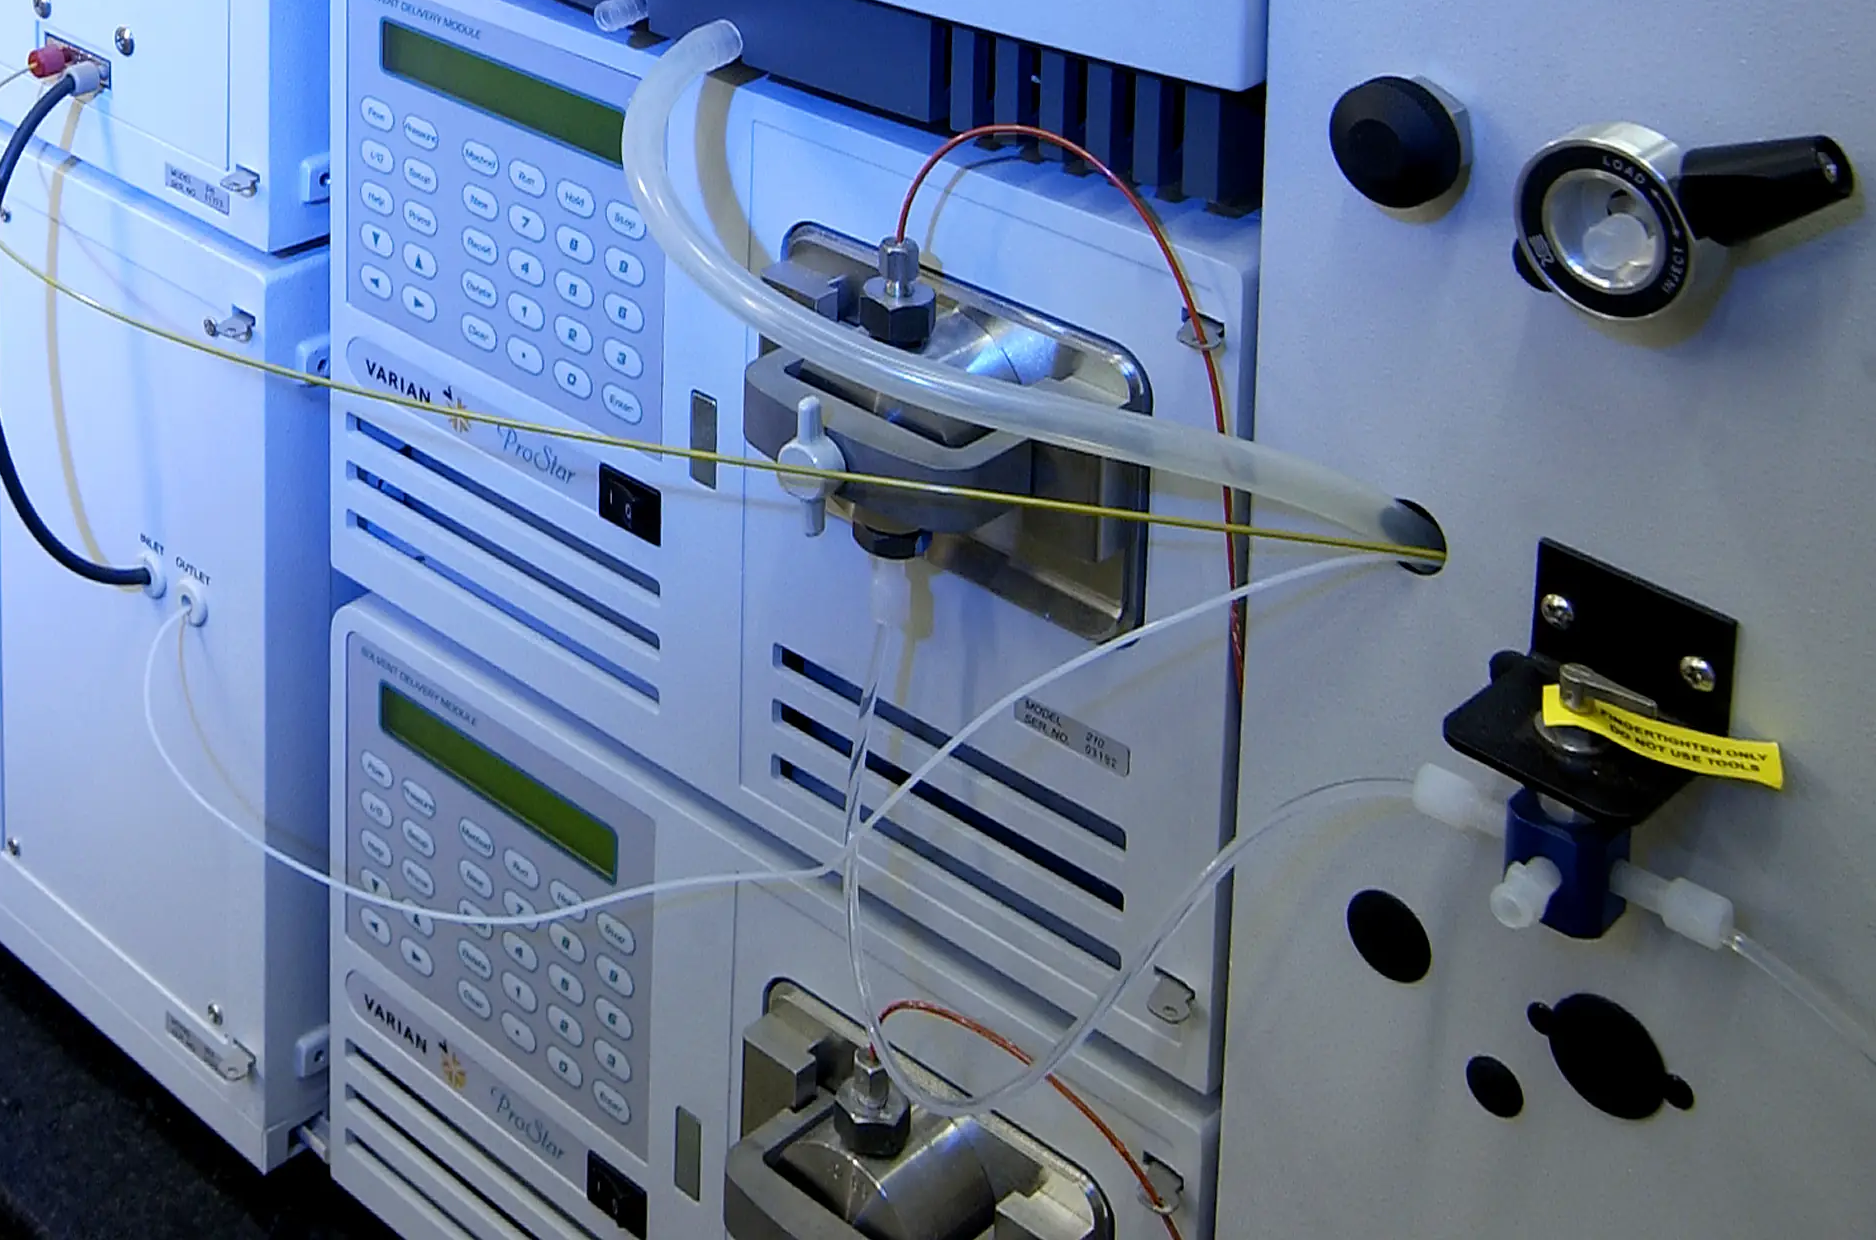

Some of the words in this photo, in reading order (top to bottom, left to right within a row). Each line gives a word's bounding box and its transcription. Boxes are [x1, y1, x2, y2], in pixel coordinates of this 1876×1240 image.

[400, 2, 443, 25] DELIVERY
[443, 16, 482, 40] MODULE
[1602, 155, 1647, 185] LOAD
[1661, 245, 1685, 295] INJECT
[365, 358, 432, 403] VARIAN
[497, 423, 576, 485] ProStar
[175, 556, 211, 586] OUTLET
[1025, 700, 1063, 728] MODEL
[1600, 709, 1722, 756] FINGERTIGHTEN
[1726, 748, 1768, 762] ONLY
[1609, 723, 1632, 741] DO
[1634, 737, 1667, 754] NOT
[1670, 749, 1702, 764] USE
[1708, 757, 1761, 772] TOOLS
[364, 993, 428, 1054] VARIAN
[490, 1086, 566, 1161] ProStar
